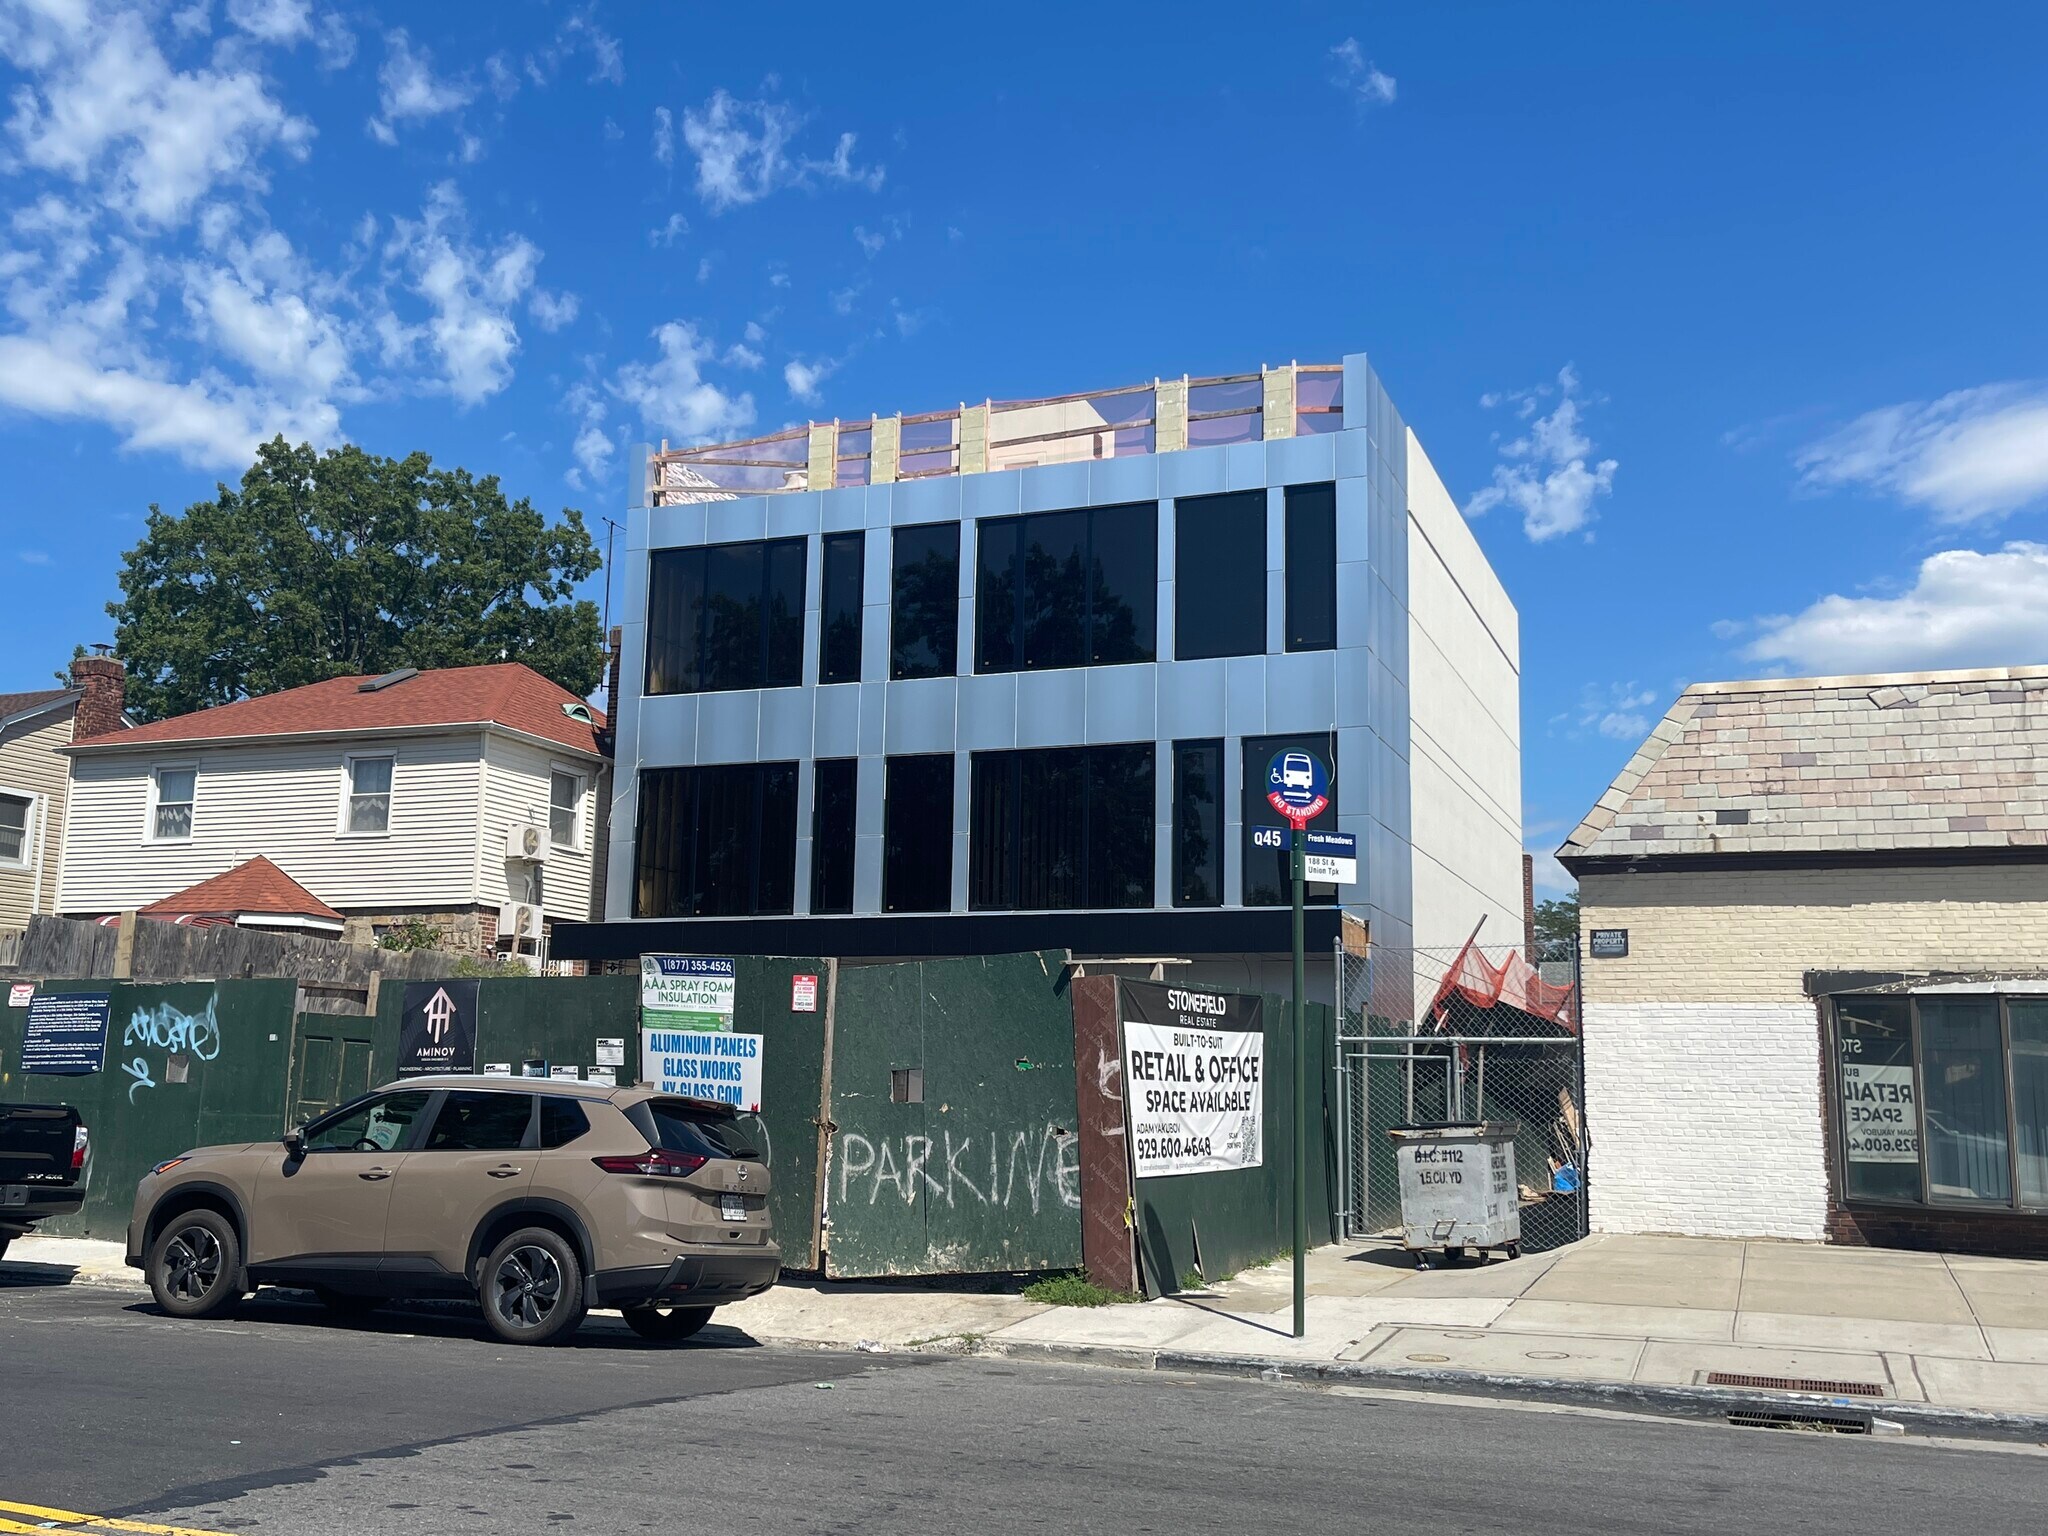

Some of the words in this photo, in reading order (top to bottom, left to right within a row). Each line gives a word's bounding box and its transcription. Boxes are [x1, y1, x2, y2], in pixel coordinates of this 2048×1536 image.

[1273, 795, 1285, 808] NO
[1286, 798, 1323, 817] STANDING
[1254, 830, 1282, 847] Q45
[1307, 833, 1324, 843] Fresh
[1325, 835, 1353, 845] Meadows
[1308, 857, 1320, 865] 188
[1308, 866, 1326, 874] Union
[1328, 867, 1339, 876] Tpk
[663, 959, 689, 971] 1(877)
[691, 960, 732, 972] 355-4526
[643, 977, 667, 990] AAA
[670, 979, 699, 991] SPRAY
[703, 981, 733, 993] FOAM
[658, 991, 717, 1004] INSULATION
[1168, 989, 1226, 1015] STONEFIELD
[1179, 1014, 1195, 1026] REAL
[1196, 1016, 1217, 1028] ESTATE
[650, 1033, 712, 1055] ALUMINUM
[715, 1036, 757, 1058] PANELS
[1173, 1033, 1223, 1049] BUILT-TO-SUIT
[416, 1047, 455, 1057] AMINOV
[663, 1057, 697, 1079] GLASS
[700, 1060, 742, 1081] WORKS
[1131, 1050, 1191, 1082] RETAIL
[1195, 1055, 1205, 1083] &
[1209, 1055, 1259, 1083] OFFICE
[1146, 1090, 1186, 1113] SPACE
[1189, 1091, 1251, 1113] AVAILABLE
[1136, 1122, 1154, 1134] ADAM
[1154, 1122, 1181, 1134] YAKUBOV
[1138, 1136, 1211, 1160] 929.600.4648
[1441, 1149, 1463, 1163] #112
